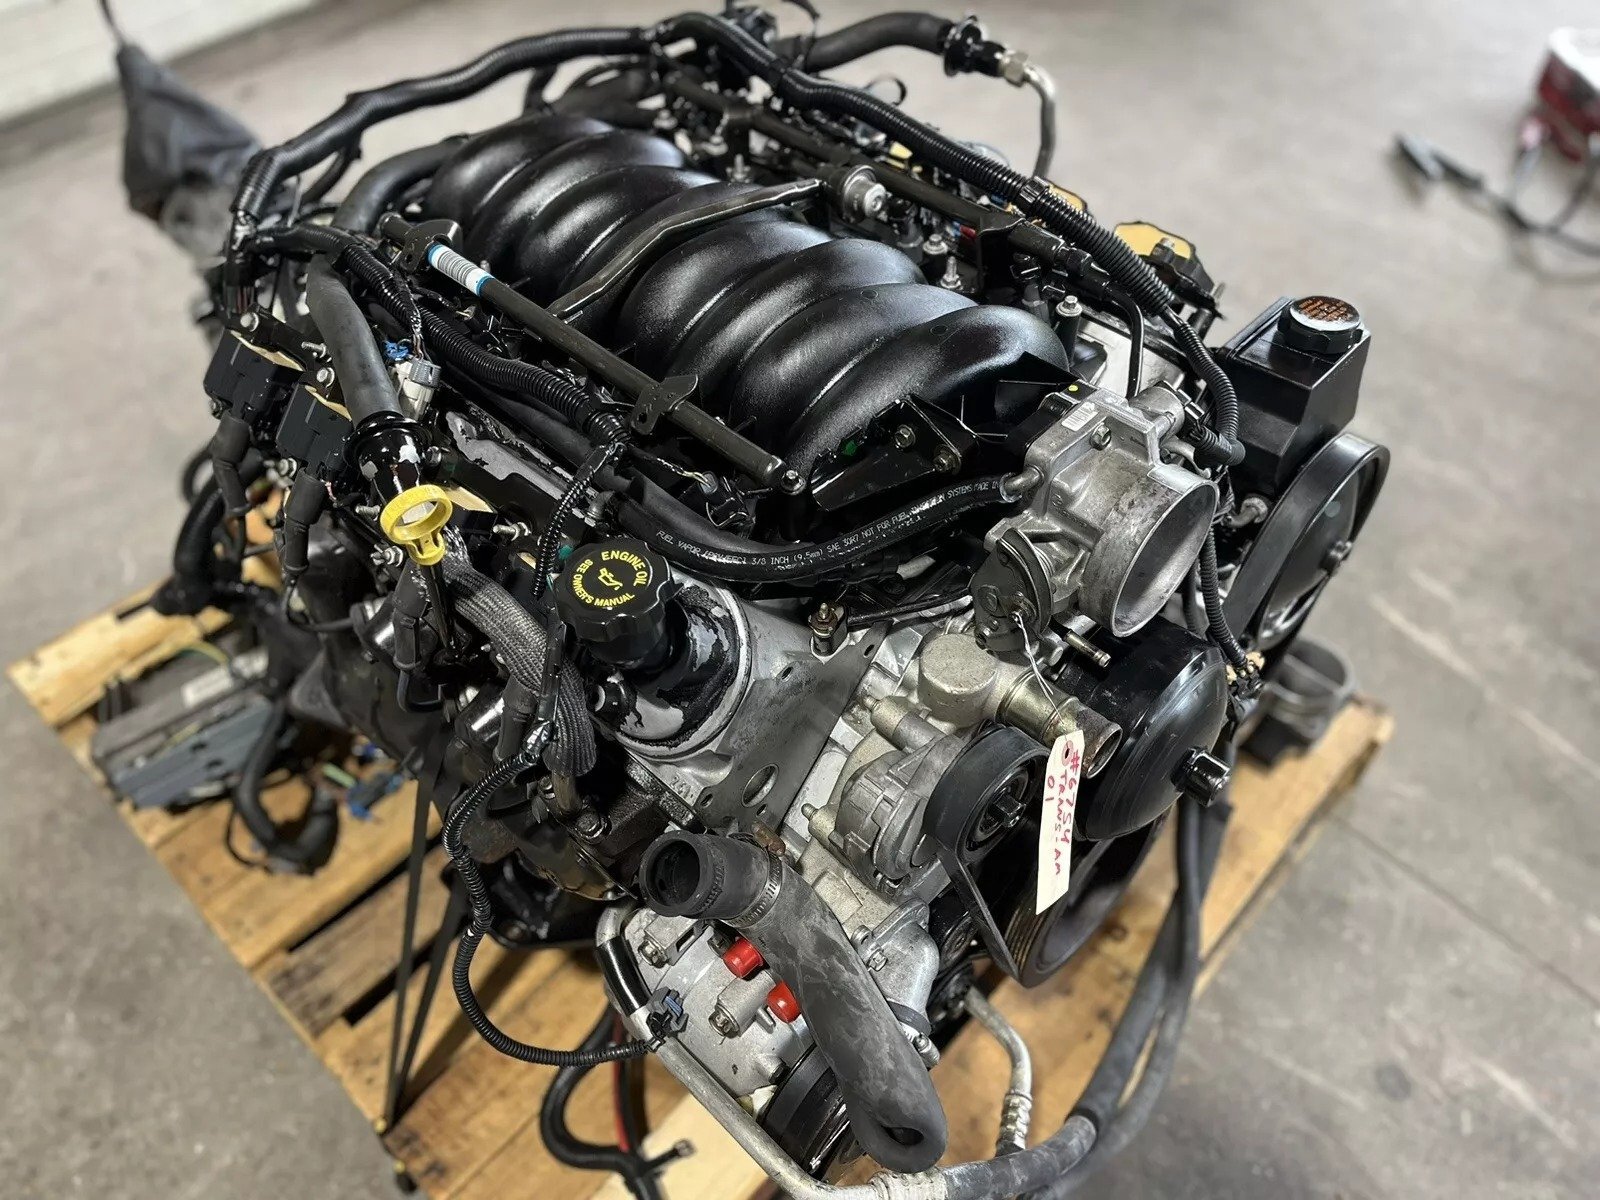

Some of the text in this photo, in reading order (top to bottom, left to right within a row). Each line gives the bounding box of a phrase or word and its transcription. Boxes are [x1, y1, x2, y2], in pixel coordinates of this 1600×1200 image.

[947, 484, 973, 499] SYSTEMS
[656, 530, 674, 545] FUEL
[678, 541, 702, 556] VAPOR
[752, 557, 767, 565] 3/8
[771, 556, 789, 565] INCH
[793, 549, 823, 562] (9.5mm)
[827, 542, 842, 553] SAE
[844, 534, 860, 547] 30R7
[862, 526, 875, 541] NOT
[877, 519, 891, 532] FOR
[892, 512, 910, 525] FUEL
[576, 559, 594, 574] SEE
[594, 593, 636, 607] MANUAL
[601, 550, 648, 587] ENGINE OIL
